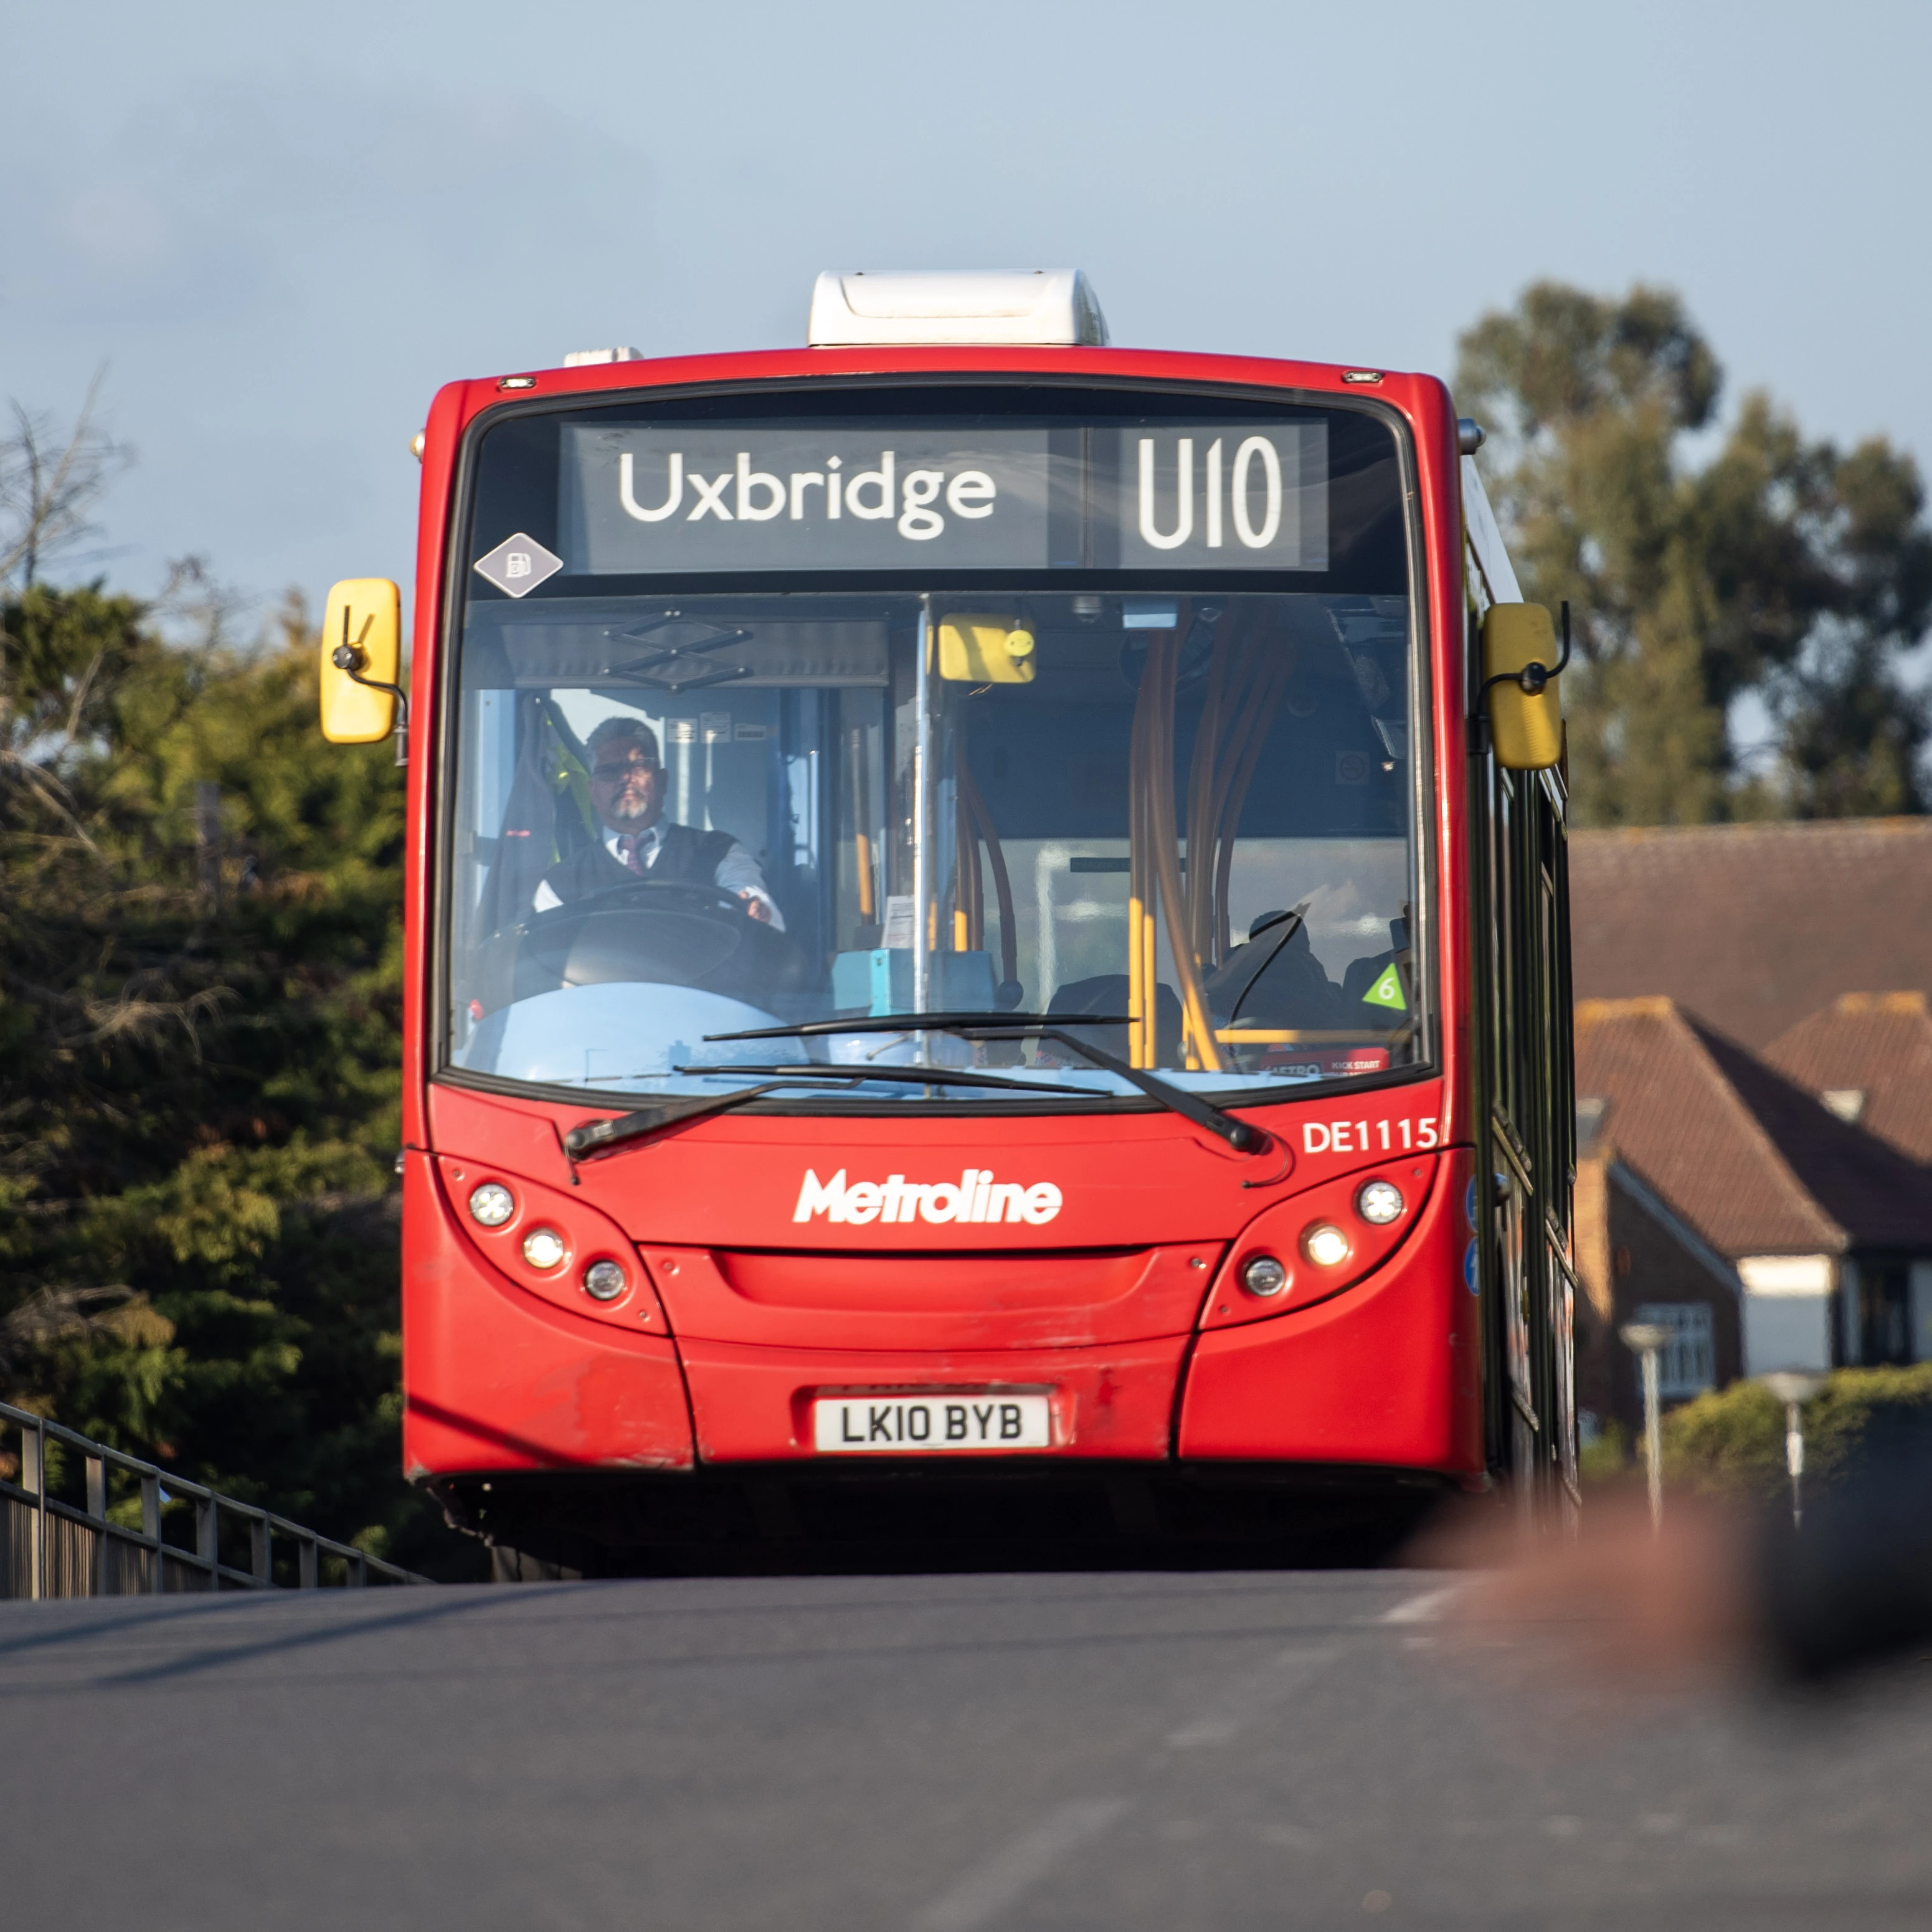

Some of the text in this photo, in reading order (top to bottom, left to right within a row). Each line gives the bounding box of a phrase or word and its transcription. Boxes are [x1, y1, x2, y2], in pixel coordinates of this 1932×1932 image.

[620, 451, 997, 540] Uxbridge
[1139, 436, 1282, 549] U10
[1378, 977, 1395, 1000] 6
[1332, 1060, 1380, 1069] KICK START
[1302, 1117, 1438, 1153] DE1115
[792, 1168, 1063, 1225] Metroline
[842, 1404, 1022, 1442] LK10 BYB
